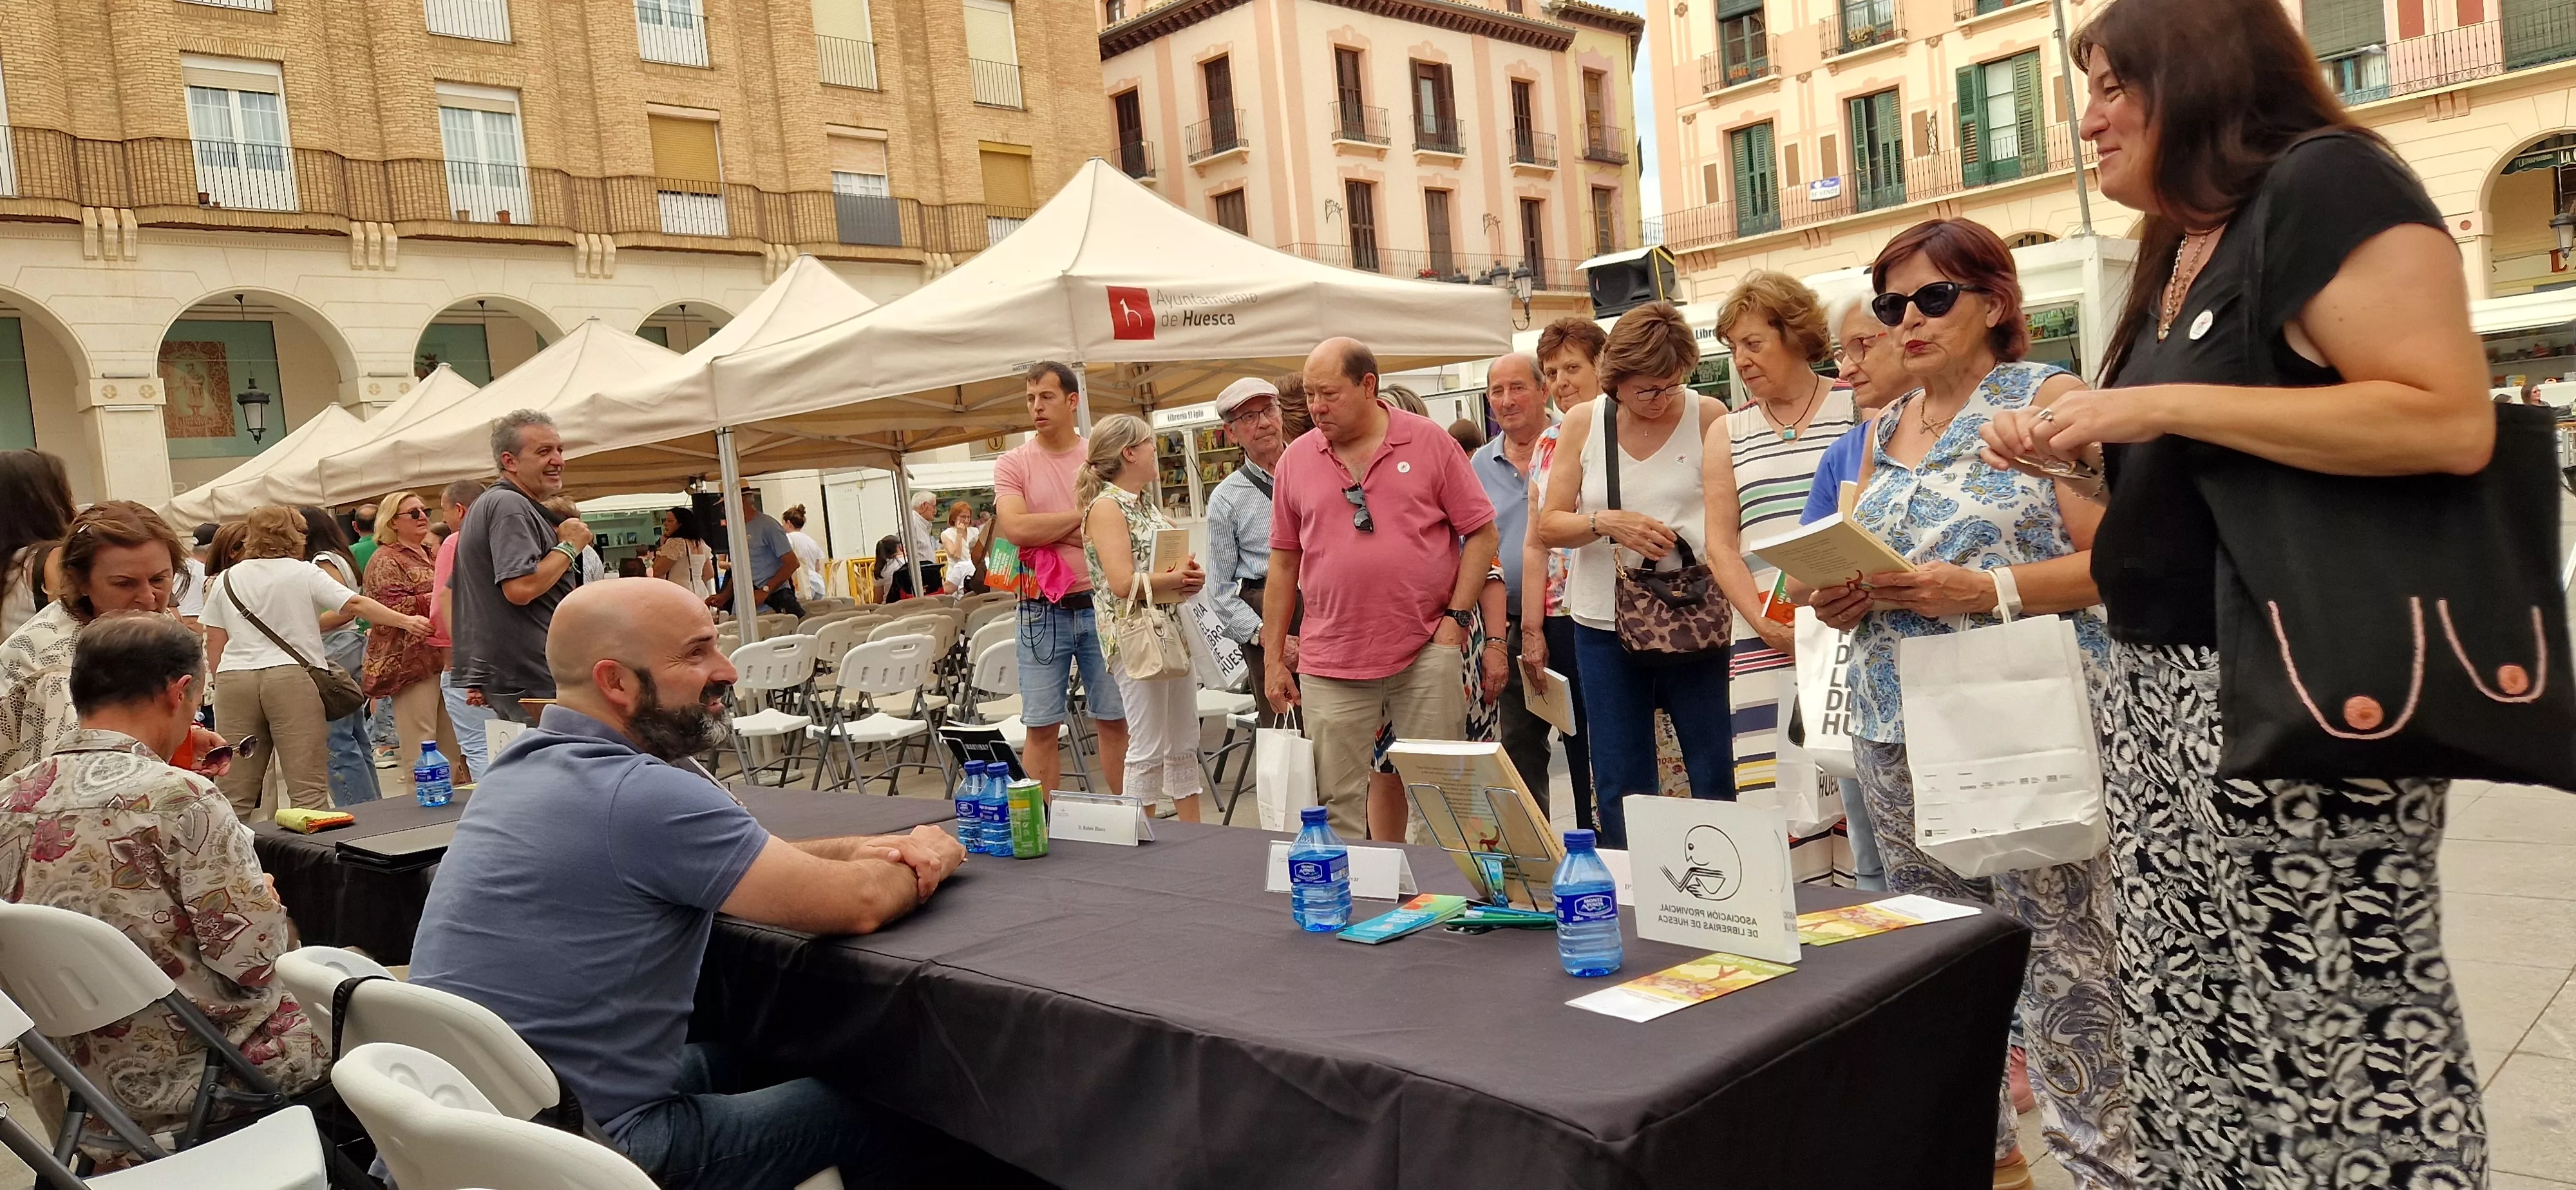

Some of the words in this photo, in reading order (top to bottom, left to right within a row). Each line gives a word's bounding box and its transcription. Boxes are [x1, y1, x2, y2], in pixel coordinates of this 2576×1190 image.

[1819, 187, 1838, 196] VENDE
[1157, 288, 1258, 309] Ayuntamiento
[1161, 310, 1178, 327] de
[1182, 310, 1236, 327] Huesca
[1168, 411, 1188, 422] Librería
[1777, 593, 1786, 604] UN
